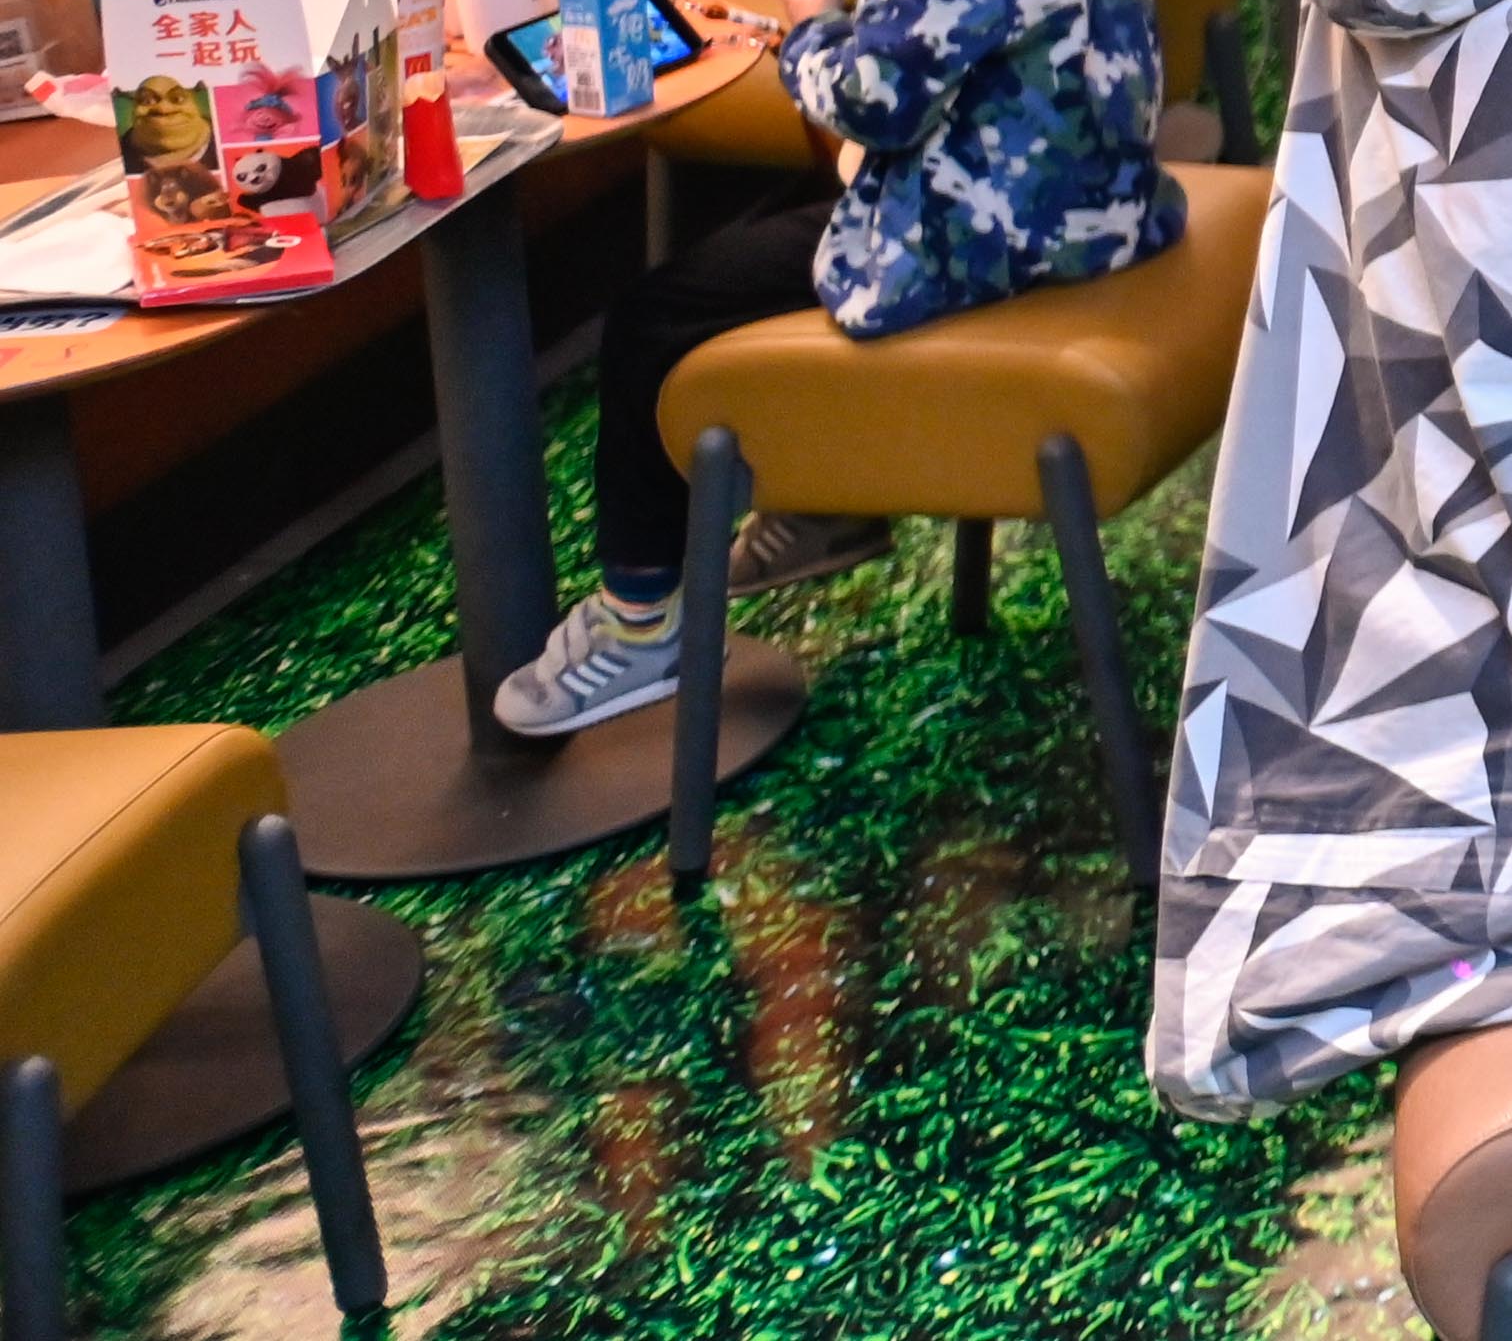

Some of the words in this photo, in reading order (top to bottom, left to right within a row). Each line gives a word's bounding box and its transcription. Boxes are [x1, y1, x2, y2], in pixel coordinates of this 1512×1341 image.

[152, 8, 257, 41] 全家人
[155, 38, 262, 67] 一起玩
